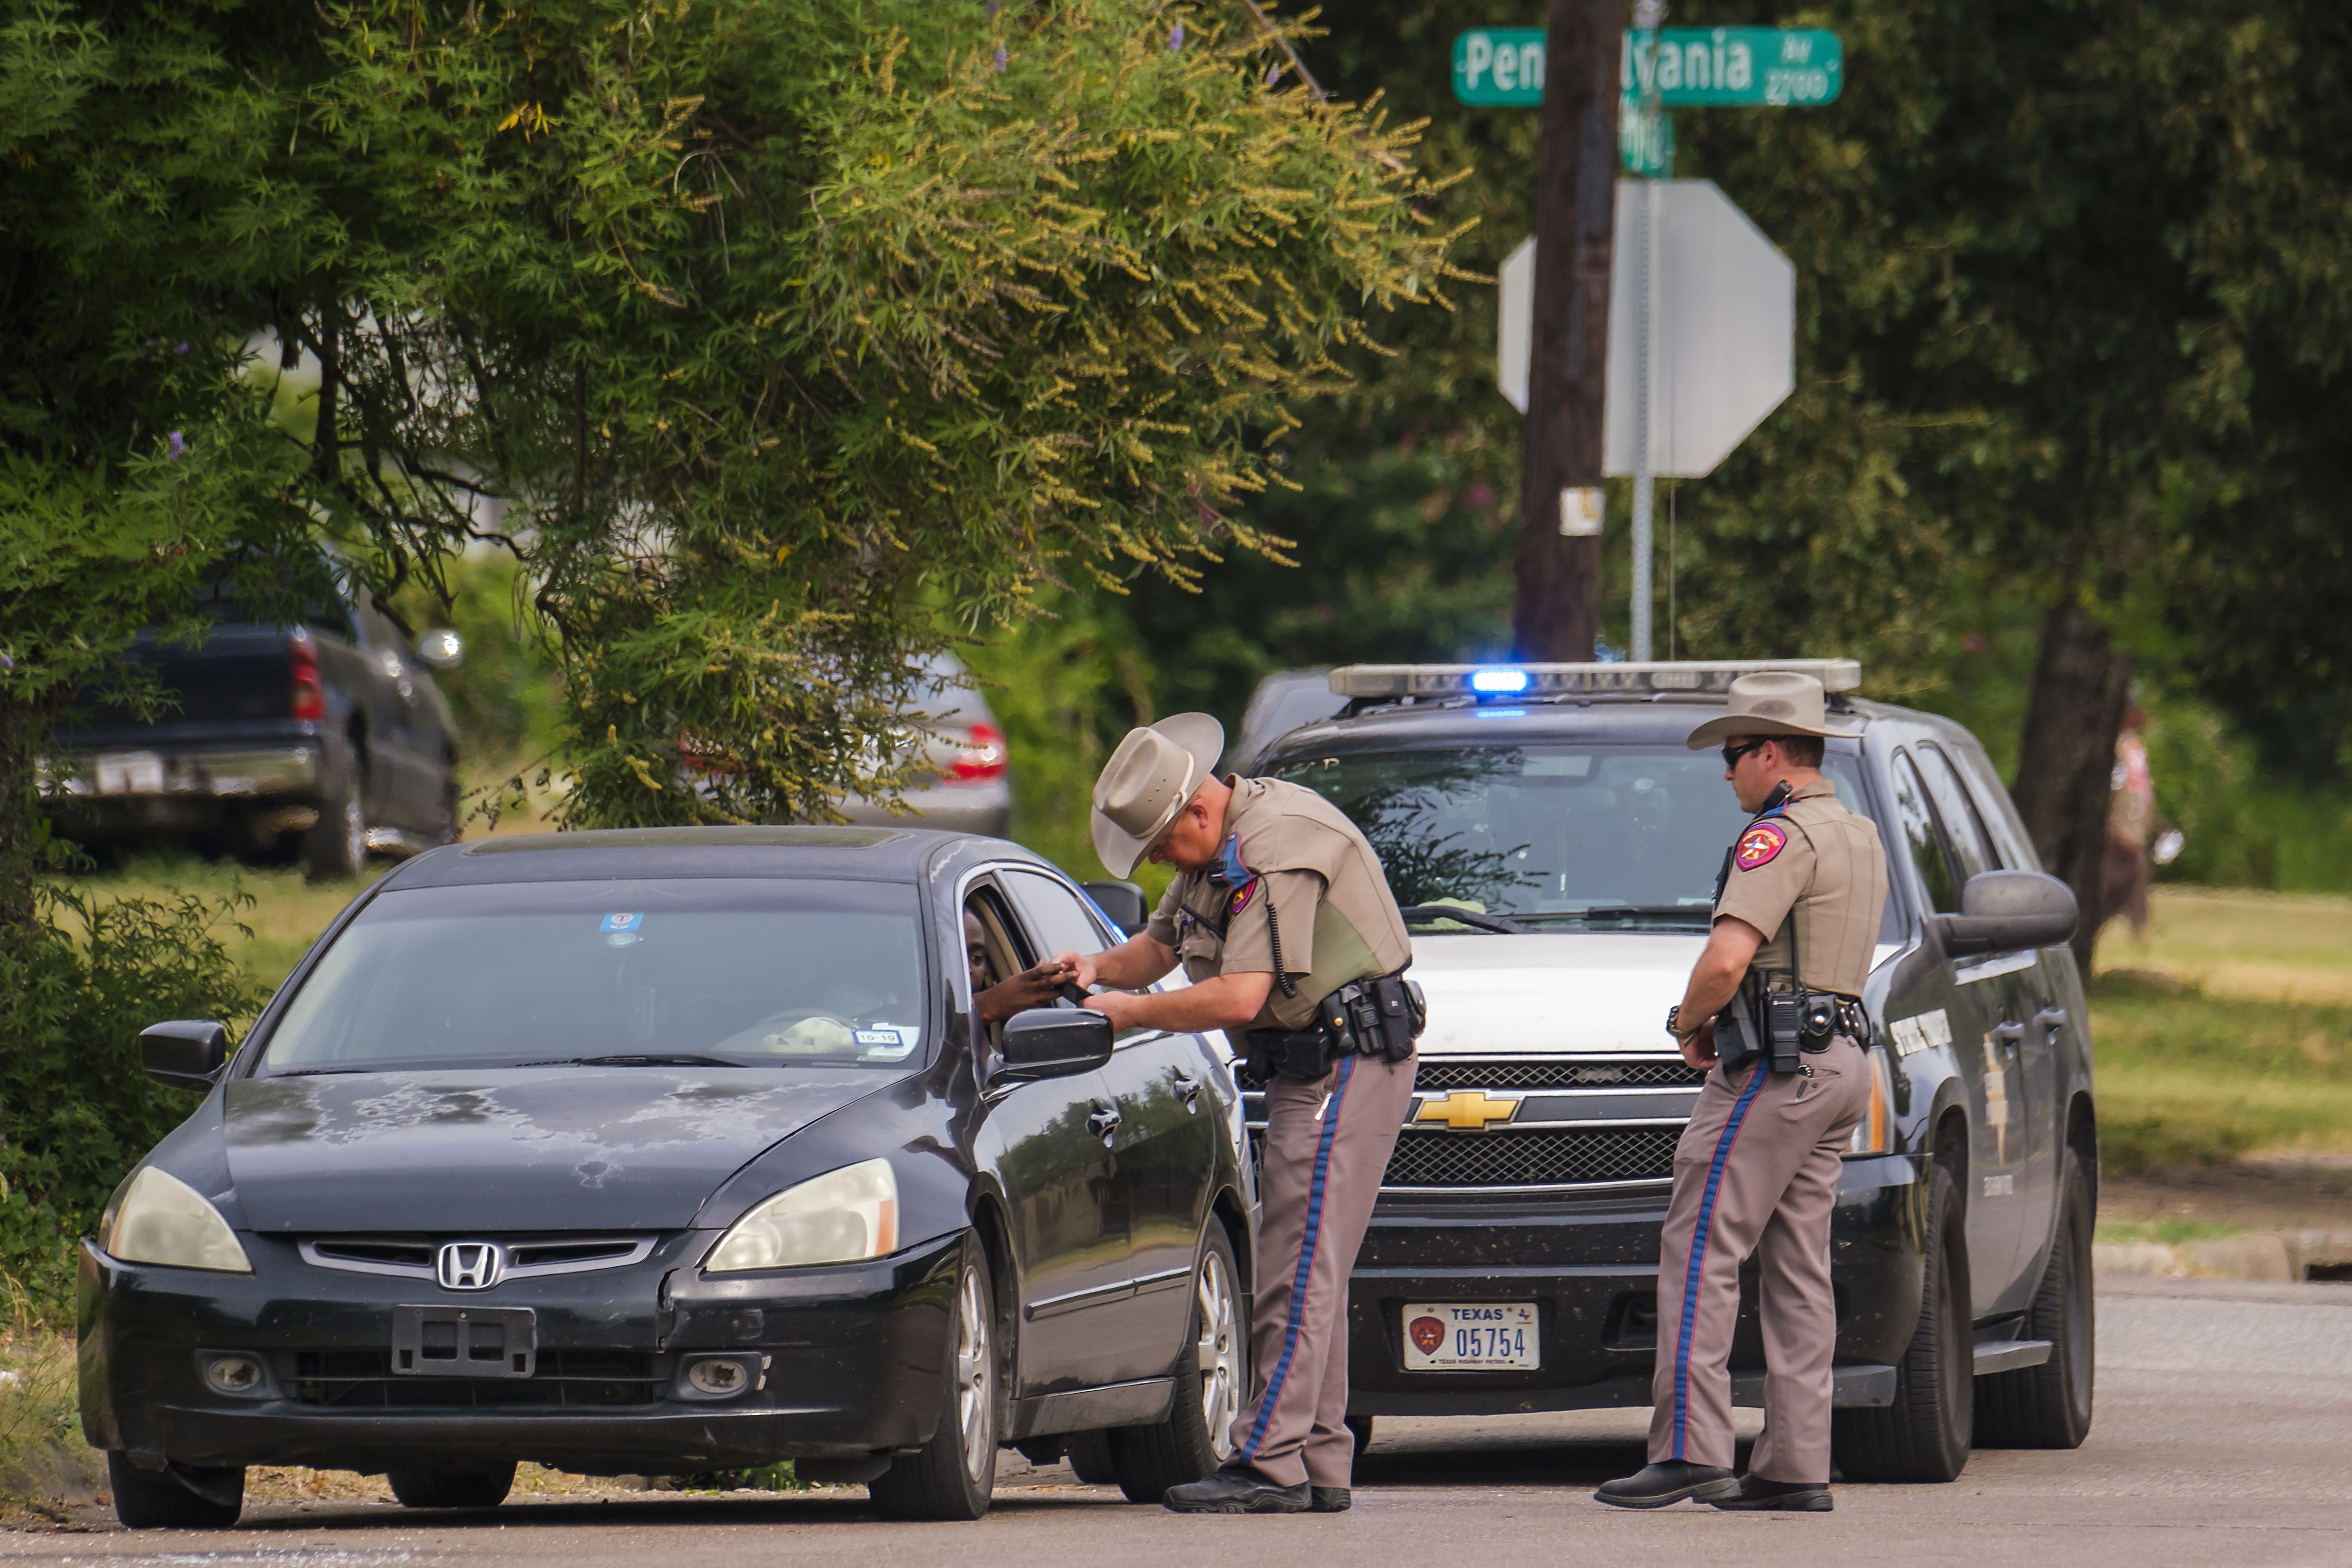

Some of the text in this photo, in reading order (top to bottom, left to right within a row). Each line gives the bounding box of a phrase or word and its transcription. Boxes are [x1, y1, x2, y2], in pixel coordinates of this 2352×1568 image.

[1465, 30, 1752, 92] Penlvania
[1451, 1308, 1503, 1320] TEXAS
[1456, 1328, 1525, 1357] 05754
